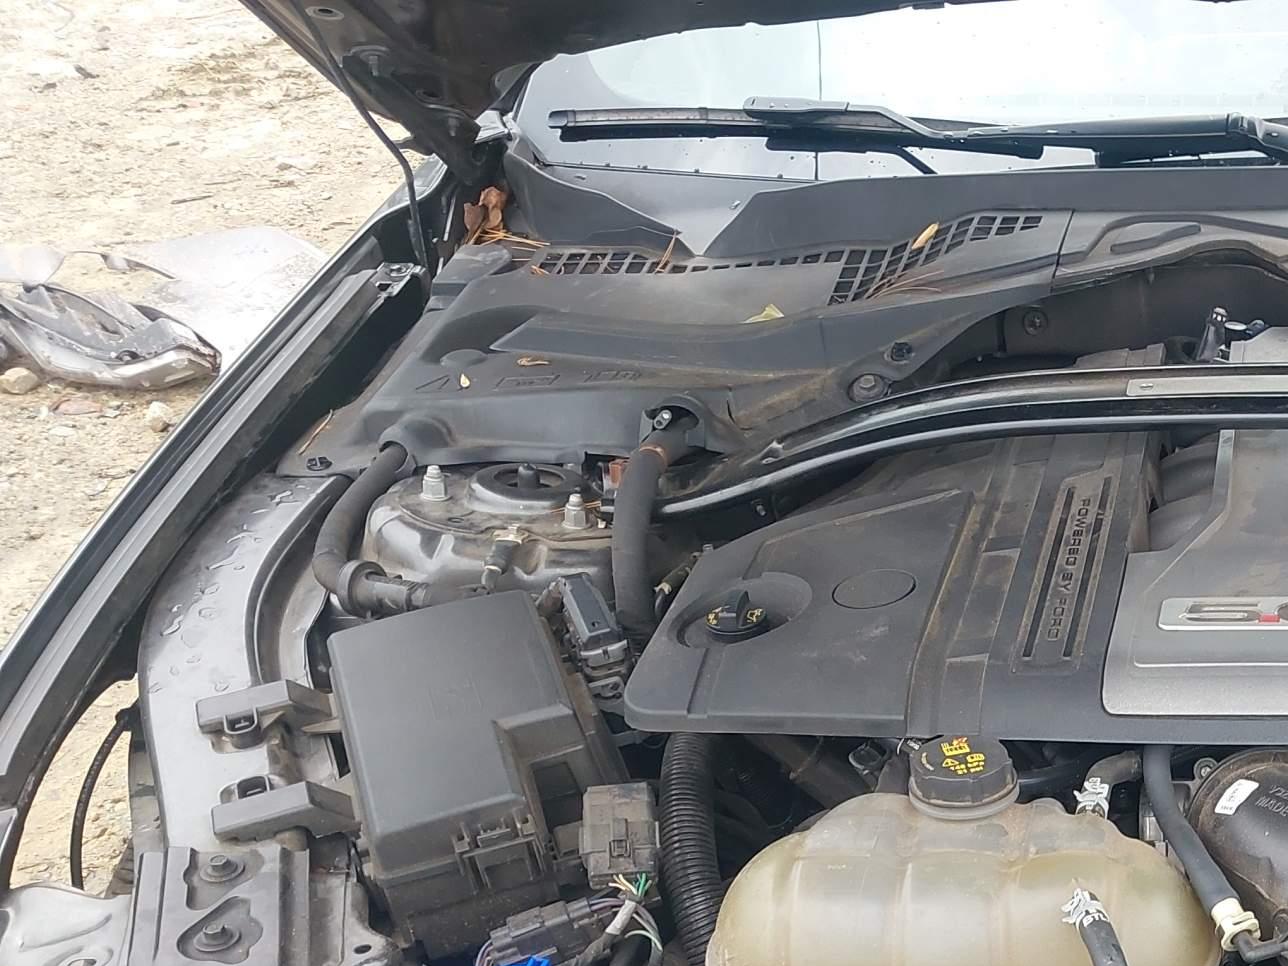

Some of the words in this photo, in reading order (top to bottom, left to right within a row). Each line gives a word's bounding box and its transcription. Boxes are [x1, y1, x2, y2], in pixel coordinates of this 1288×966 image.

[1064, 498, 1091, 566] POWERED
[1058, 572, 1074, 595] BY
[1047, 597, 1067, 640] FORD
